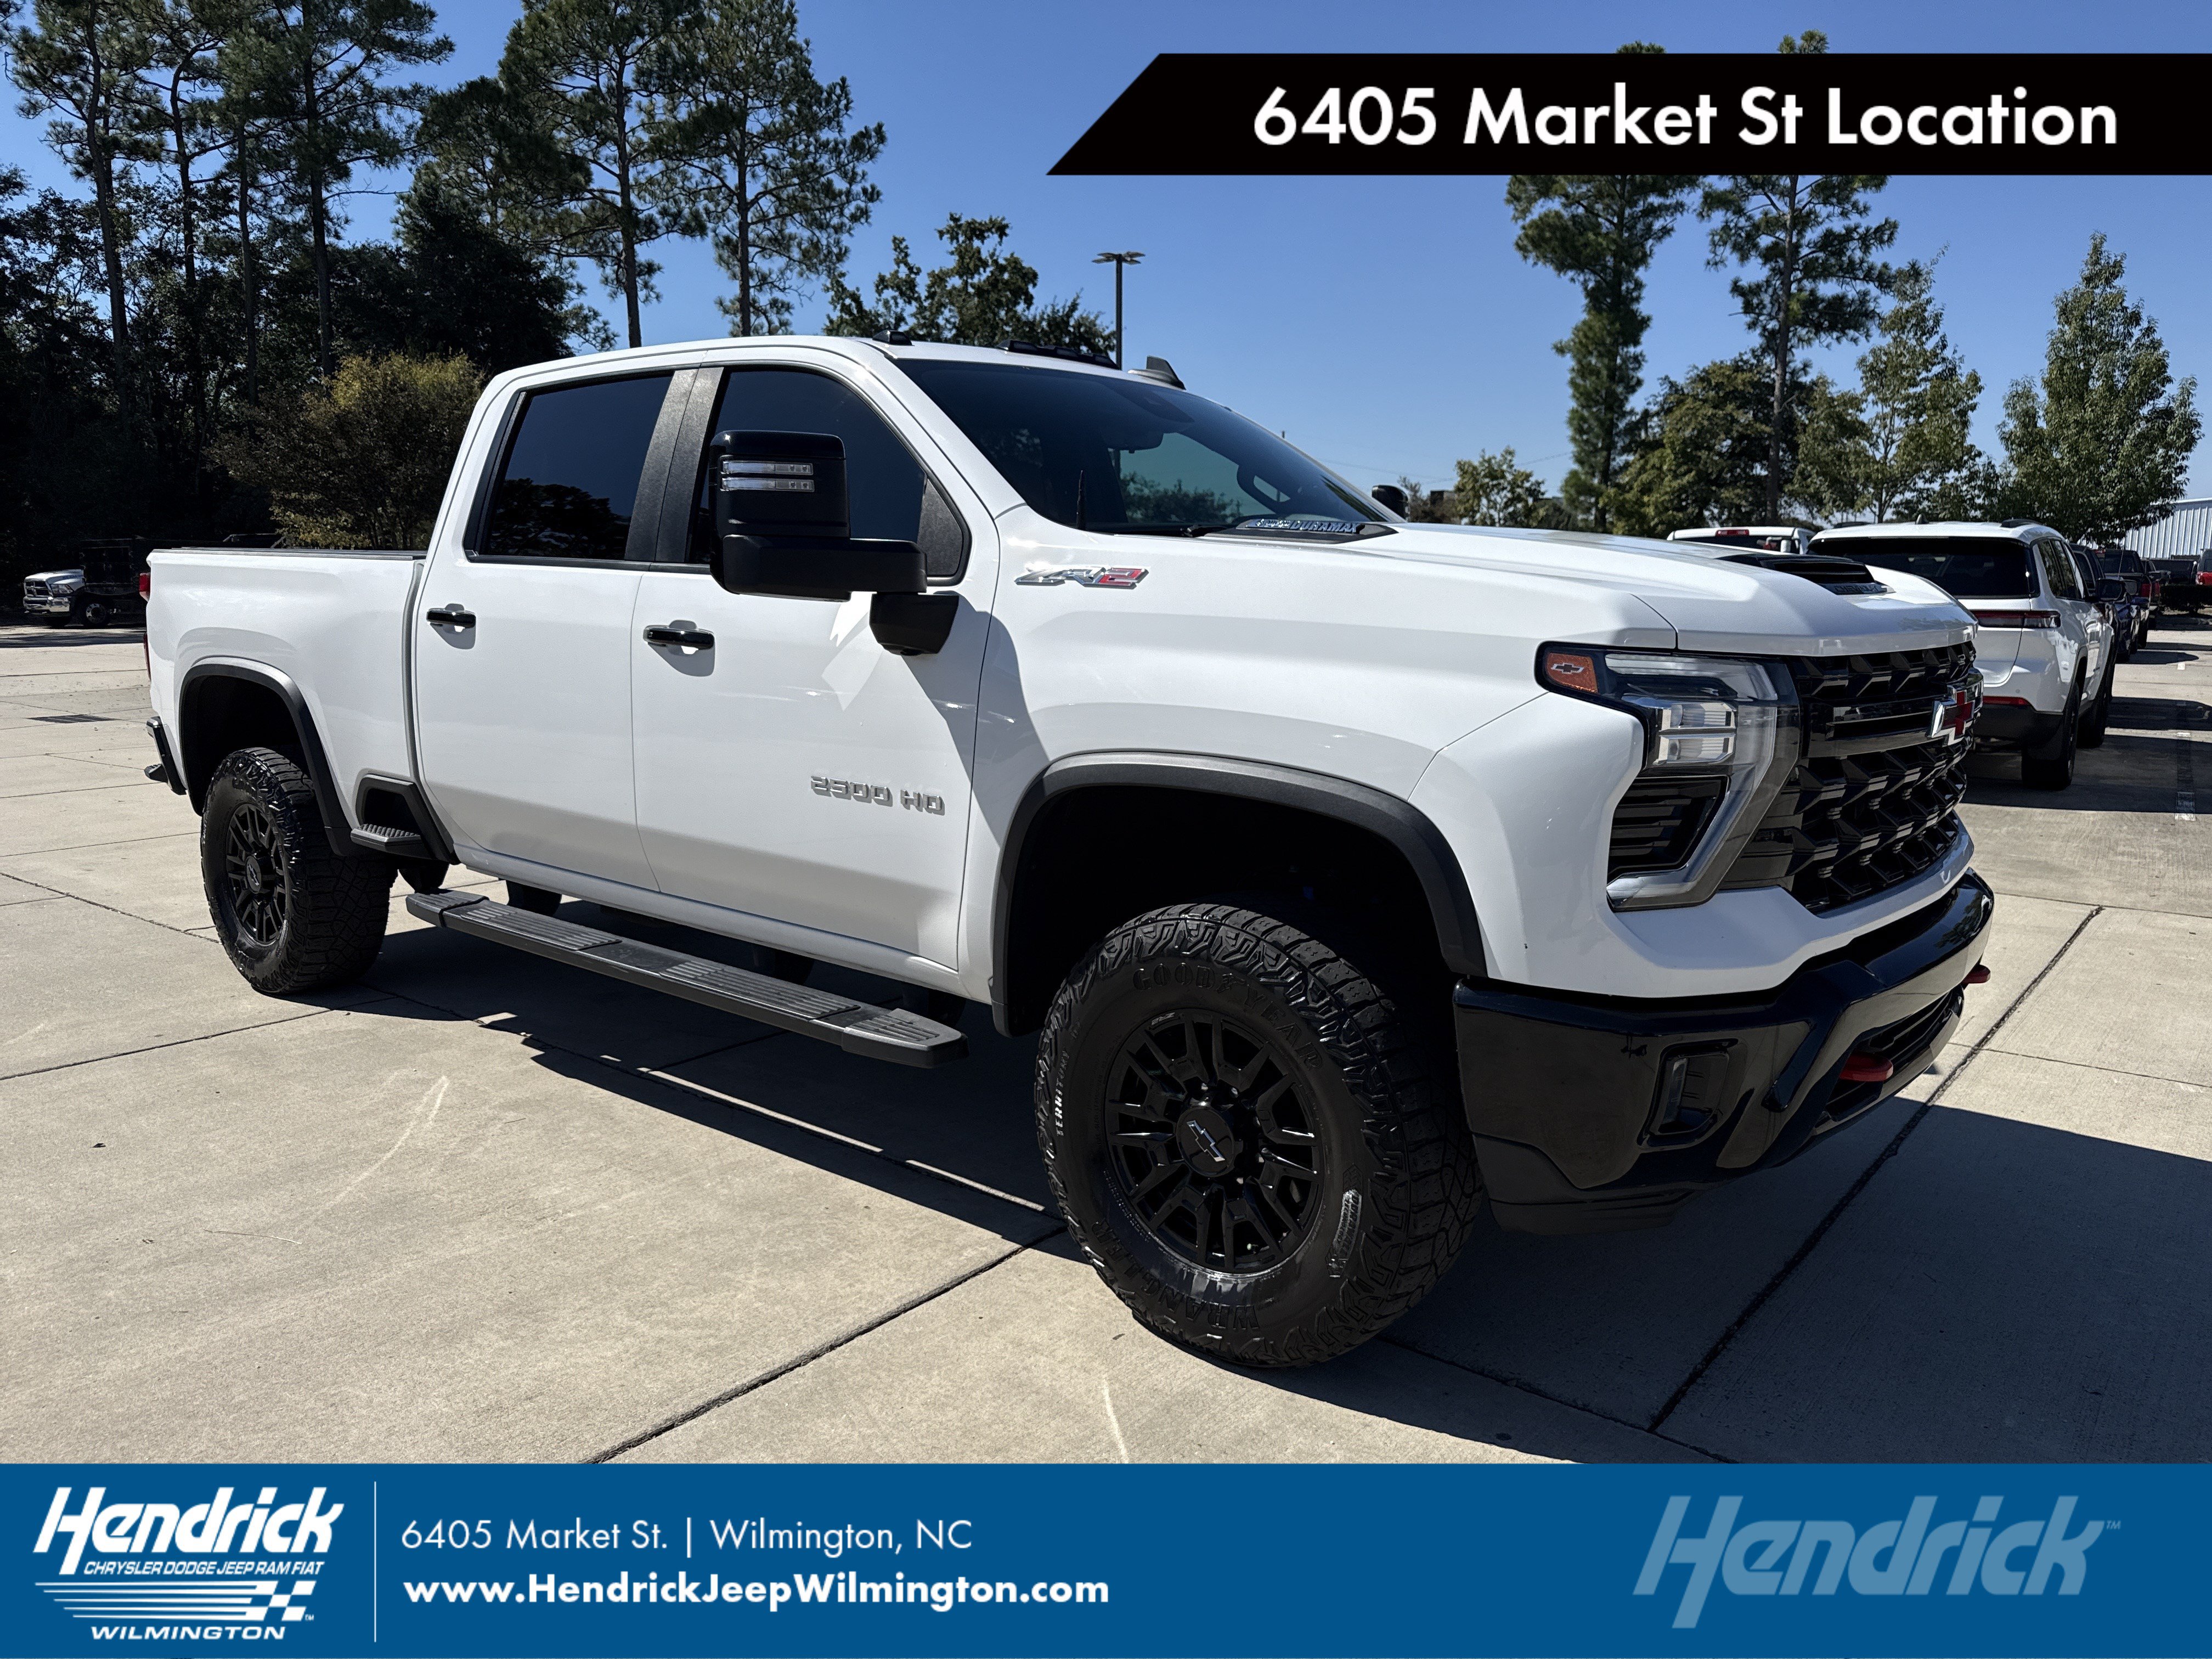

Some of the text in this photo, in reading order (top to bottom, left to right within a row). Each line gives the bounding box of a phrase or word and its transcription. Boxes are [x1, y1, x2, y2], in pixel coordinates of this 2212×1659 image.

[1290, 521, 1358, 534] DURAMAX
[1014, 563, 1149, 590] ZR2
[811, 775, 943, 812] 2500 HD
[1132, 963, 1323, 1068] GOODYEAR
[1054, 1049, 1070, 1137] TERRITORY
[1092, 1218, 1260, 1331] WRANGLER
